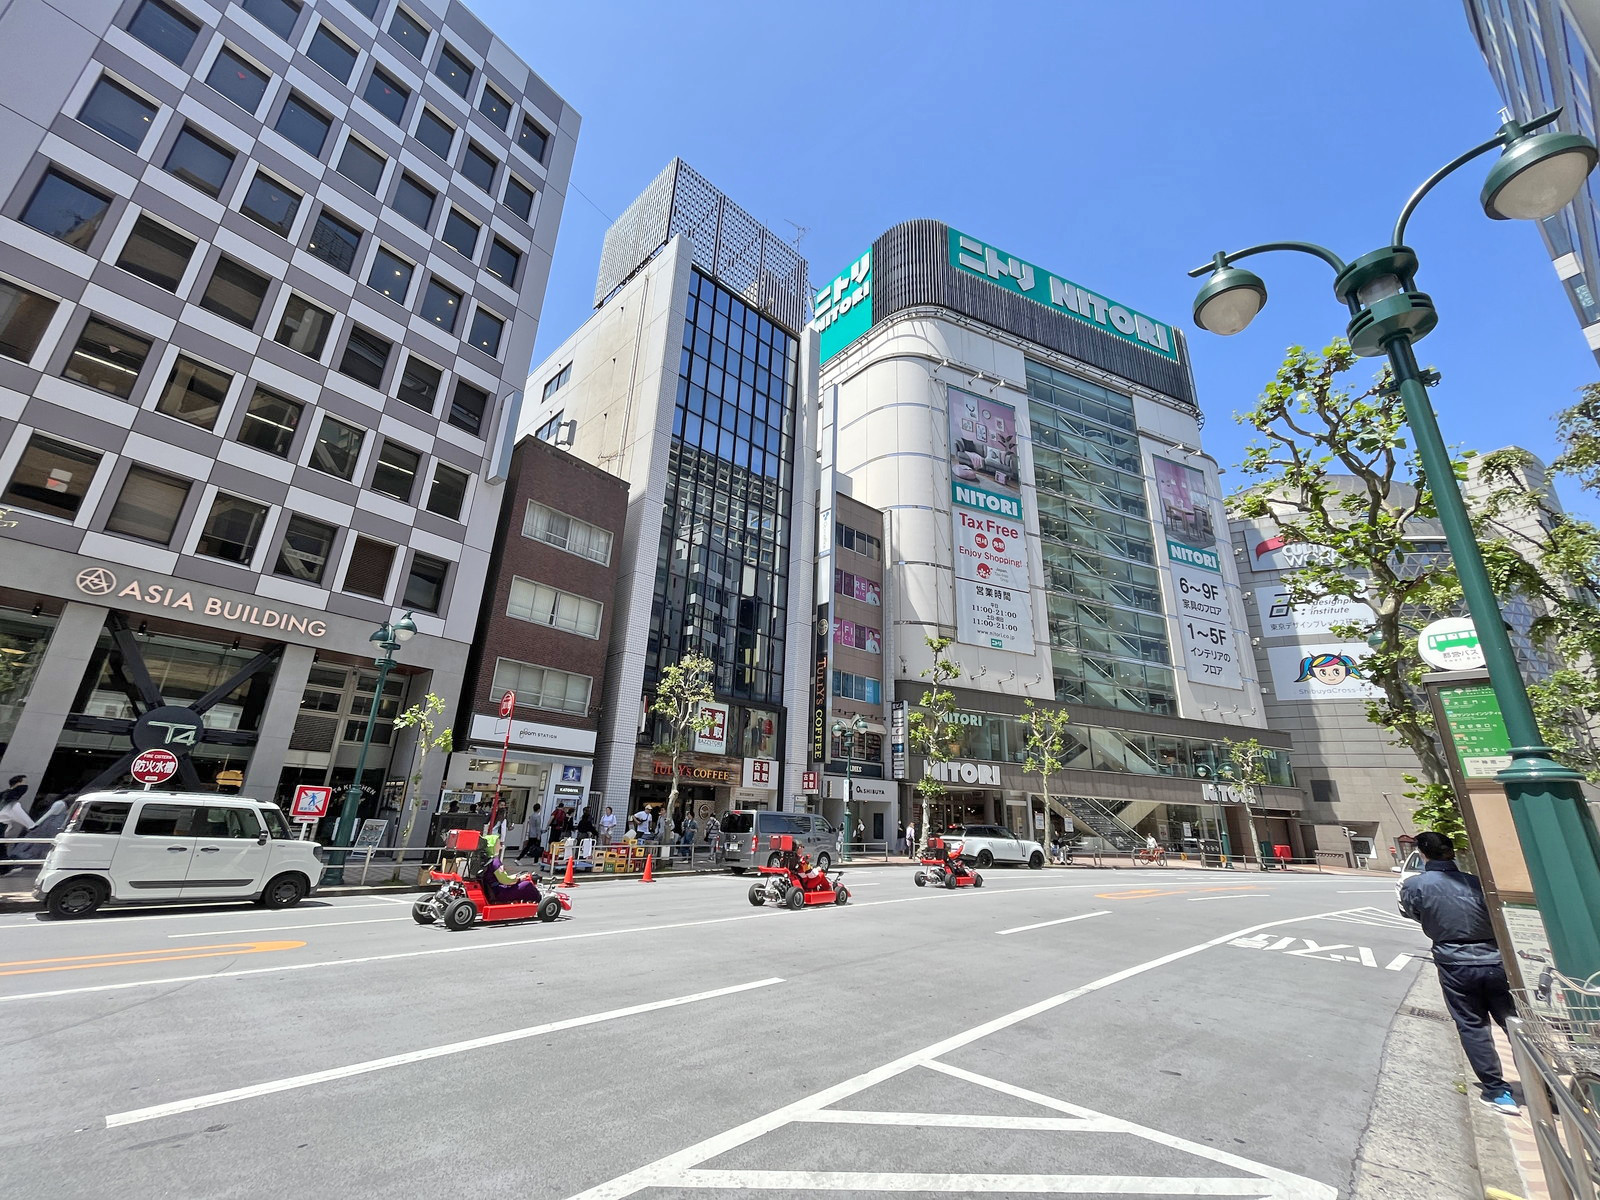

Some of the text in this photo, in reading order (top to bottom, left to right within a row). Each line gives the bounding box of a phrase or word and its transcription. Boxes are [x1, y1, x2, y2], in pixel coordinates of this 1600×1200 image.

[814, 252, 870, 319] ニトリ
[959, 235, 1170, 352] ニトリ NITORI
[814, 280, 870, 333] NITORI
[955, 485, 1019, 517] NITORI
[959, 512, 1019, 539] Tax Free
[959, 545, 1023, 568] Enjoy Shopping!
[1170, 544, 1217, 569] NITORI
[976, 585, 1011, 601] 営業時間
[118, 580, 327, 638] ASIA BUILDING
[972, 604, 1017, 619] 11:00-21:00
[1182, 598, 1222, 615] 家具のフロア
[1310, 606, 1349, 615] institute
[973, 618, 1018, 631] 11:00-21:00
[1190, 647, 1231, 662] インテリアの
[1202, 663, 1223, 676] フロア
[814, 656, 827, 759] TULLY'S COFFEE
[148, 720, 196, 746] T4
[134, 759, 176, 774] 防火水槽
[652, 761, 730, 780] TULY'S COFFEE
[343, 784, 377, 796] KIHEN
